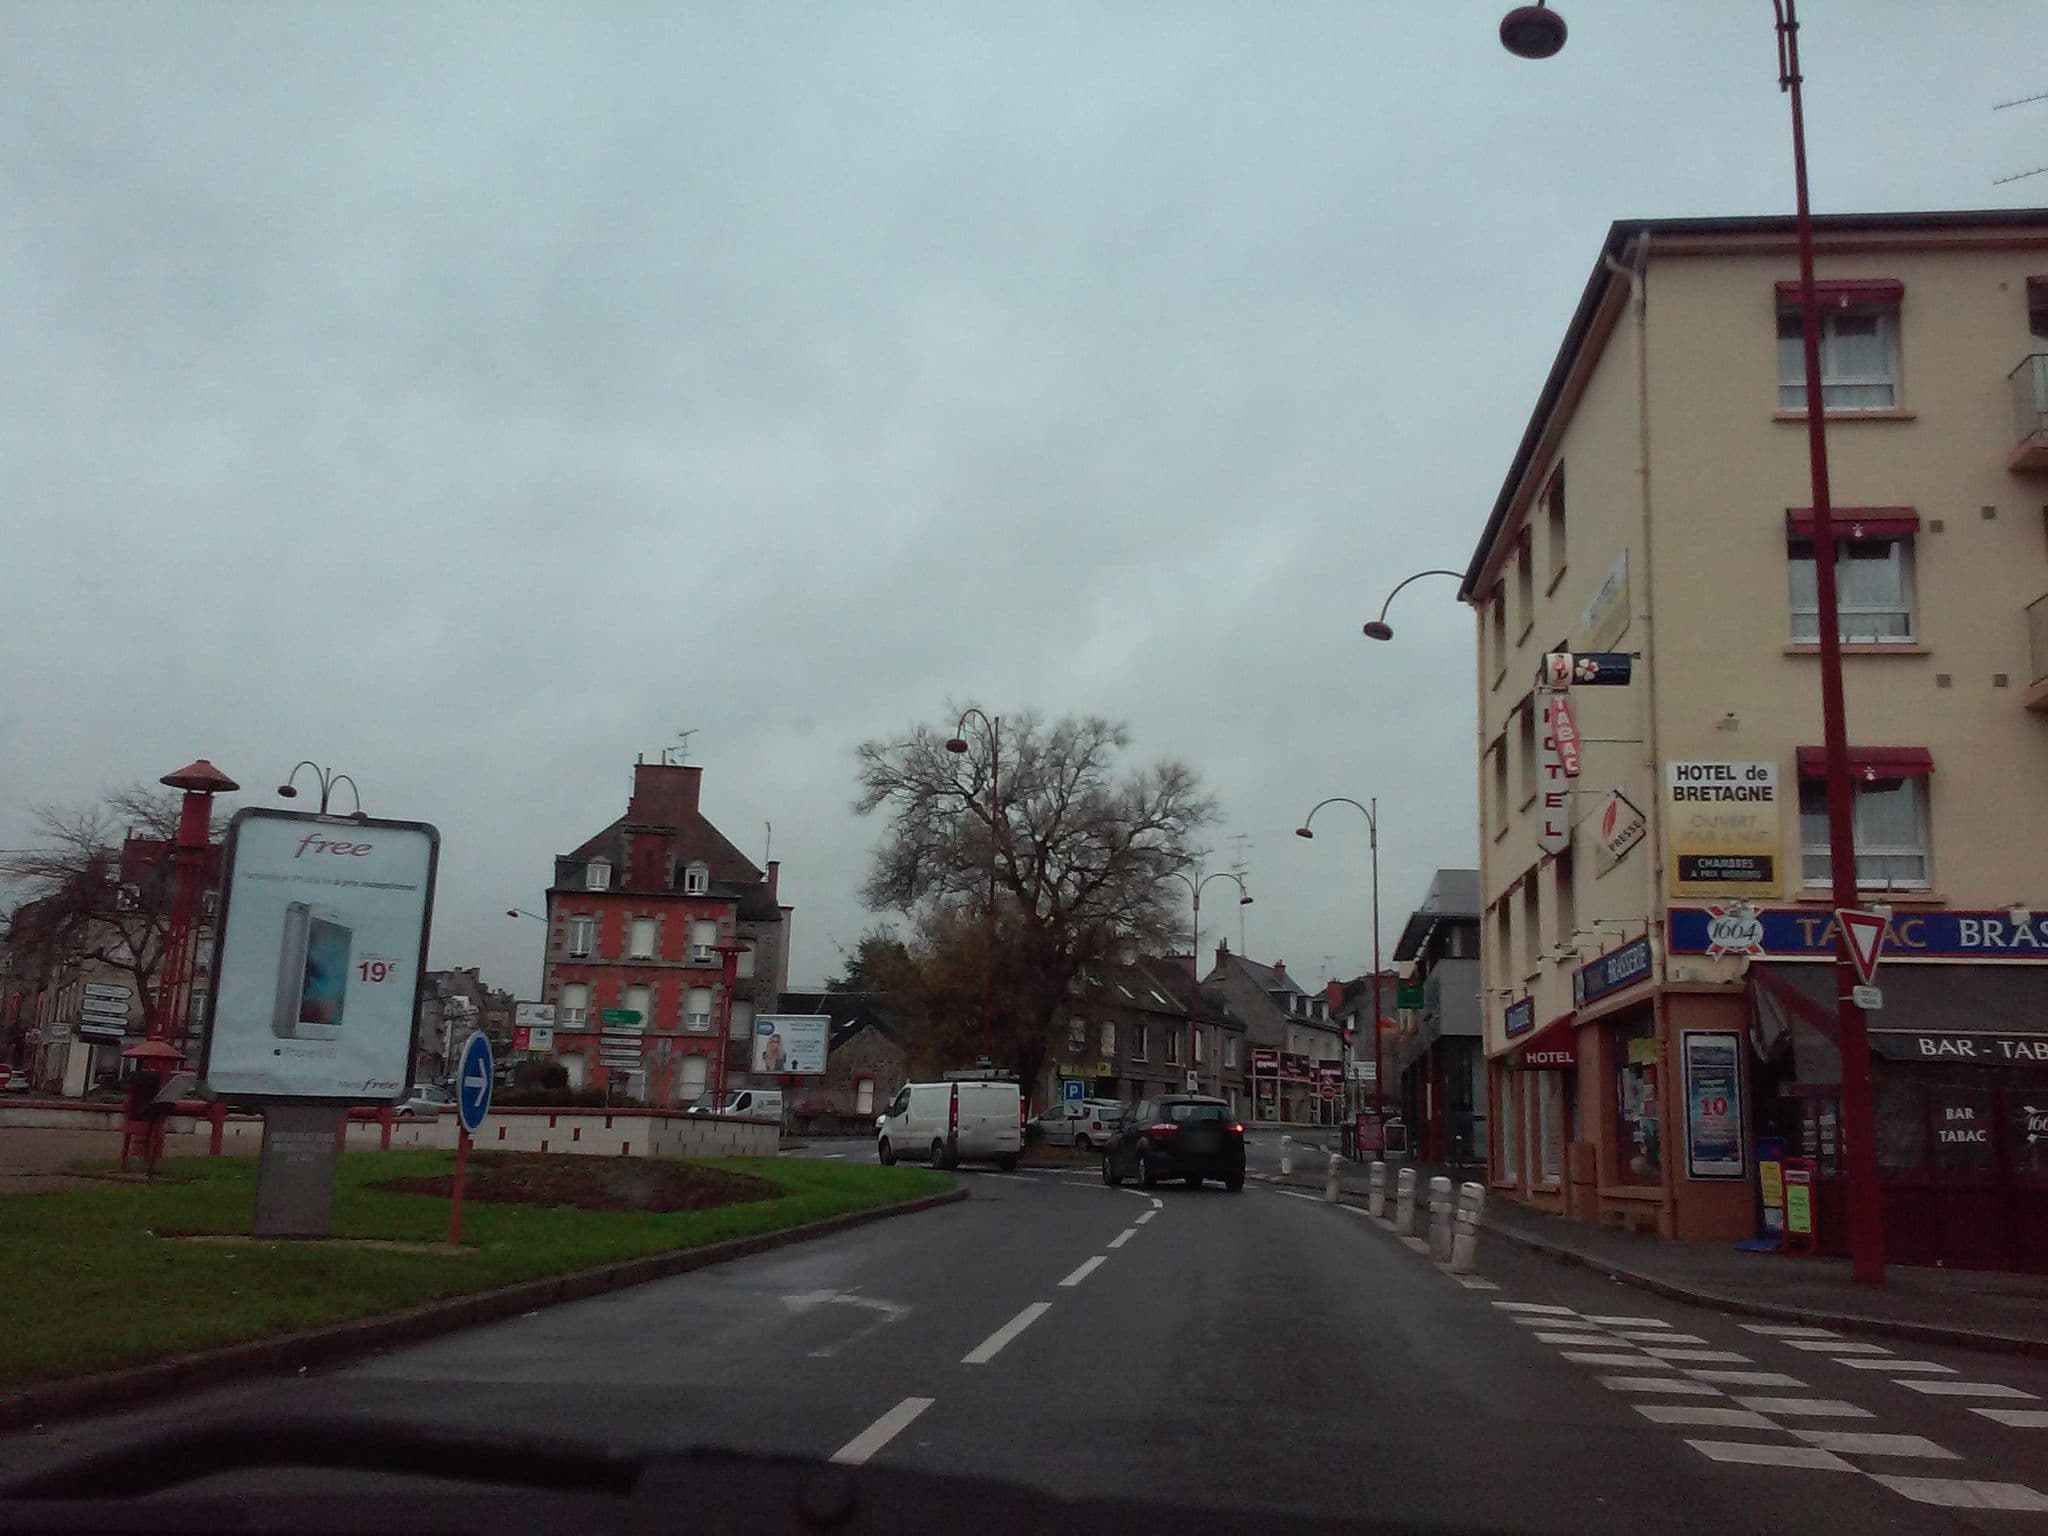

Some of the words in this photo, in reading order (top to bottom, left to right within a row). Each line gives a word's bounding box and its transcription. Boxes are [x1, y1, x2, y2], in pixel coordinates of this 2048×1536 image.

[1677, 764, 1737, 781] HOTEL
[1745, 764, 1768, 781] de
[1673, 785, 1773, 802] BRETAGNE
[1607, 820, 1643, 853] PRESSE
[293, 833, 373, 859] free
[1710, 920, 1758, 941] 1664
[1796, 918, 1927, 948] TAAC
[1526, 1051, 1574, 1064] HOTEL
[1919, 1038, 1977, 1057] BAR
[1997, 1040, 2048, 1061] TAB
[362, 1078, 399, 1092] free
[1069, 1085, 1079, 1097] P
[1700, 1096, 1728, 1117] 10
[1945, 1108, 1975, 1121] BAR
[1939, 1130, 1987, 1143] TABAC
